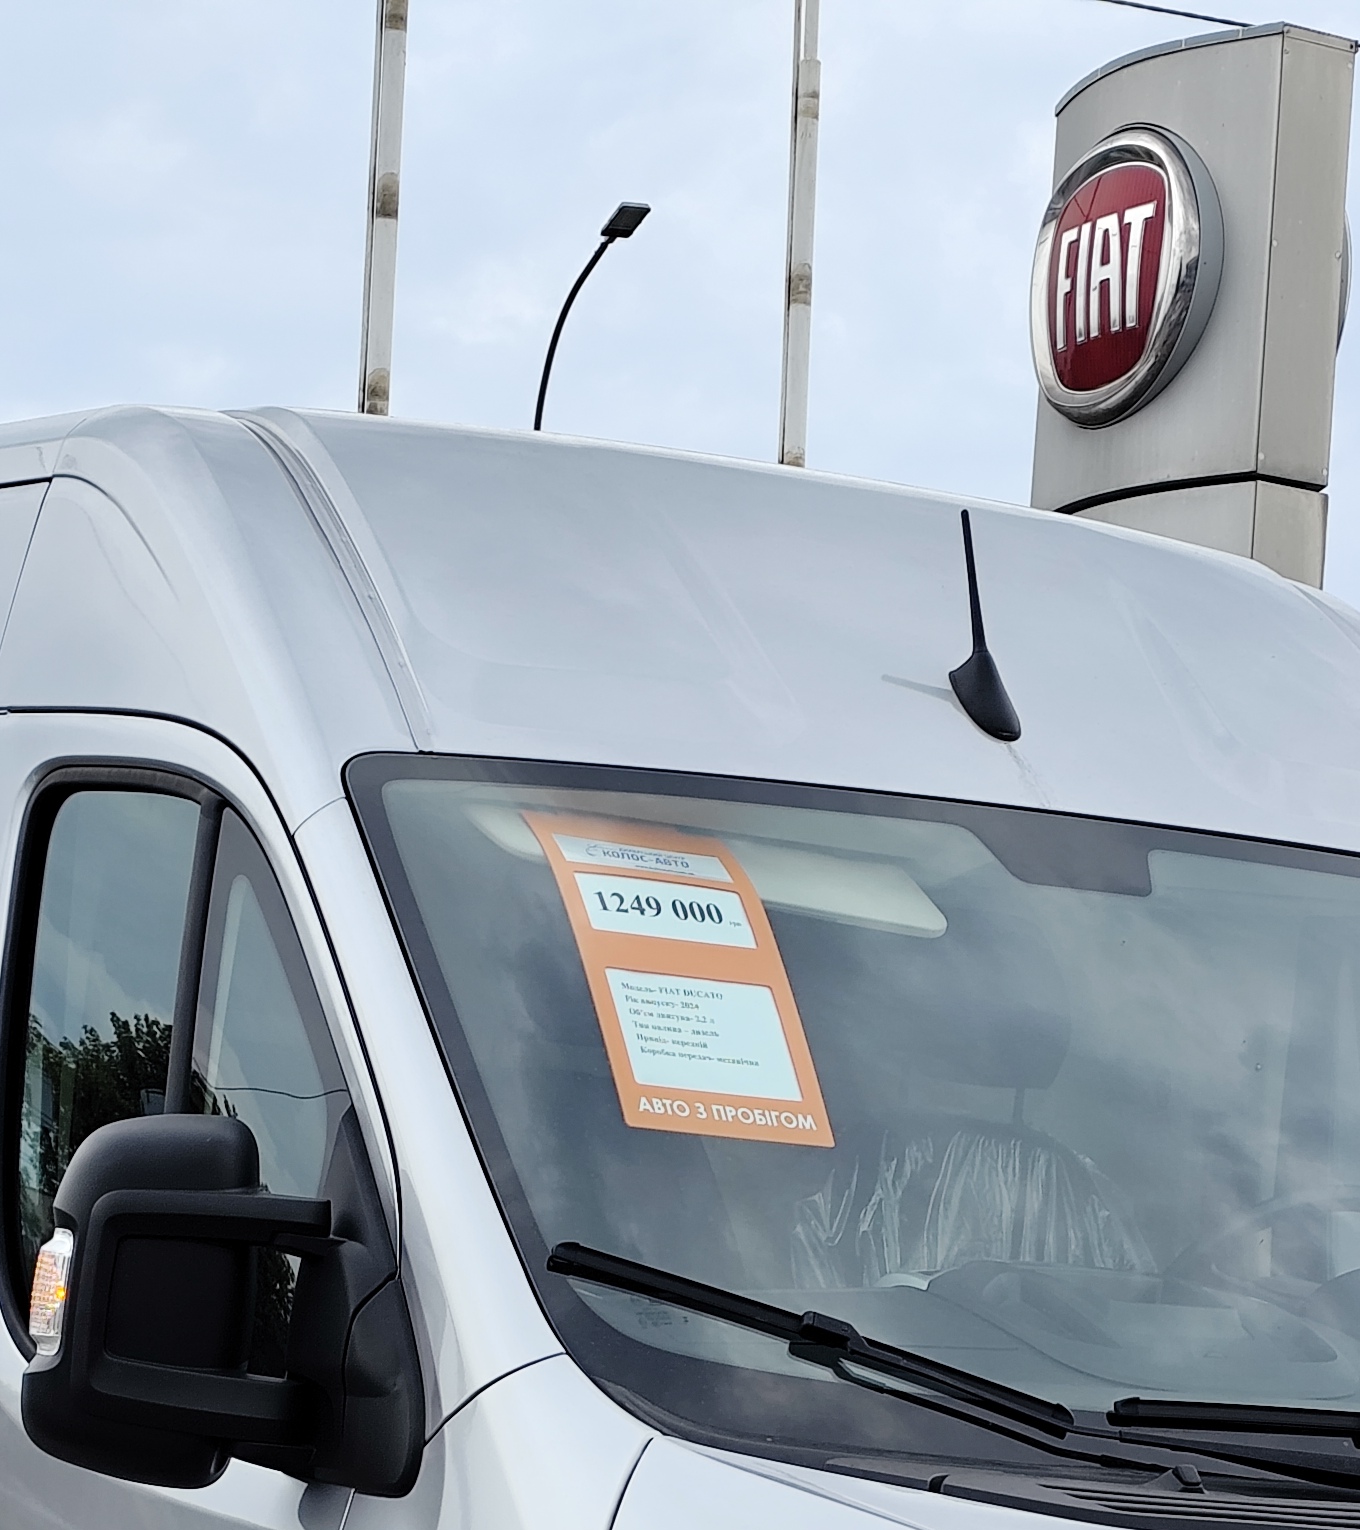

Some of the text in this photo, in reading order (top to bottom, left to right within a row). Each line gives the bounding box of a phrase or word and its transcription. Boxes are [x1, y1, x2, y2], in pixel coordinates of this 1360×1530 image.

[1056, 200, 1158, 352] FIAT
[593, 890, 662, 918] 1249
[671, 898, 723, 925] 000
[638, 1096, 818, 1131] АВТО З ПРОБІГОМ
